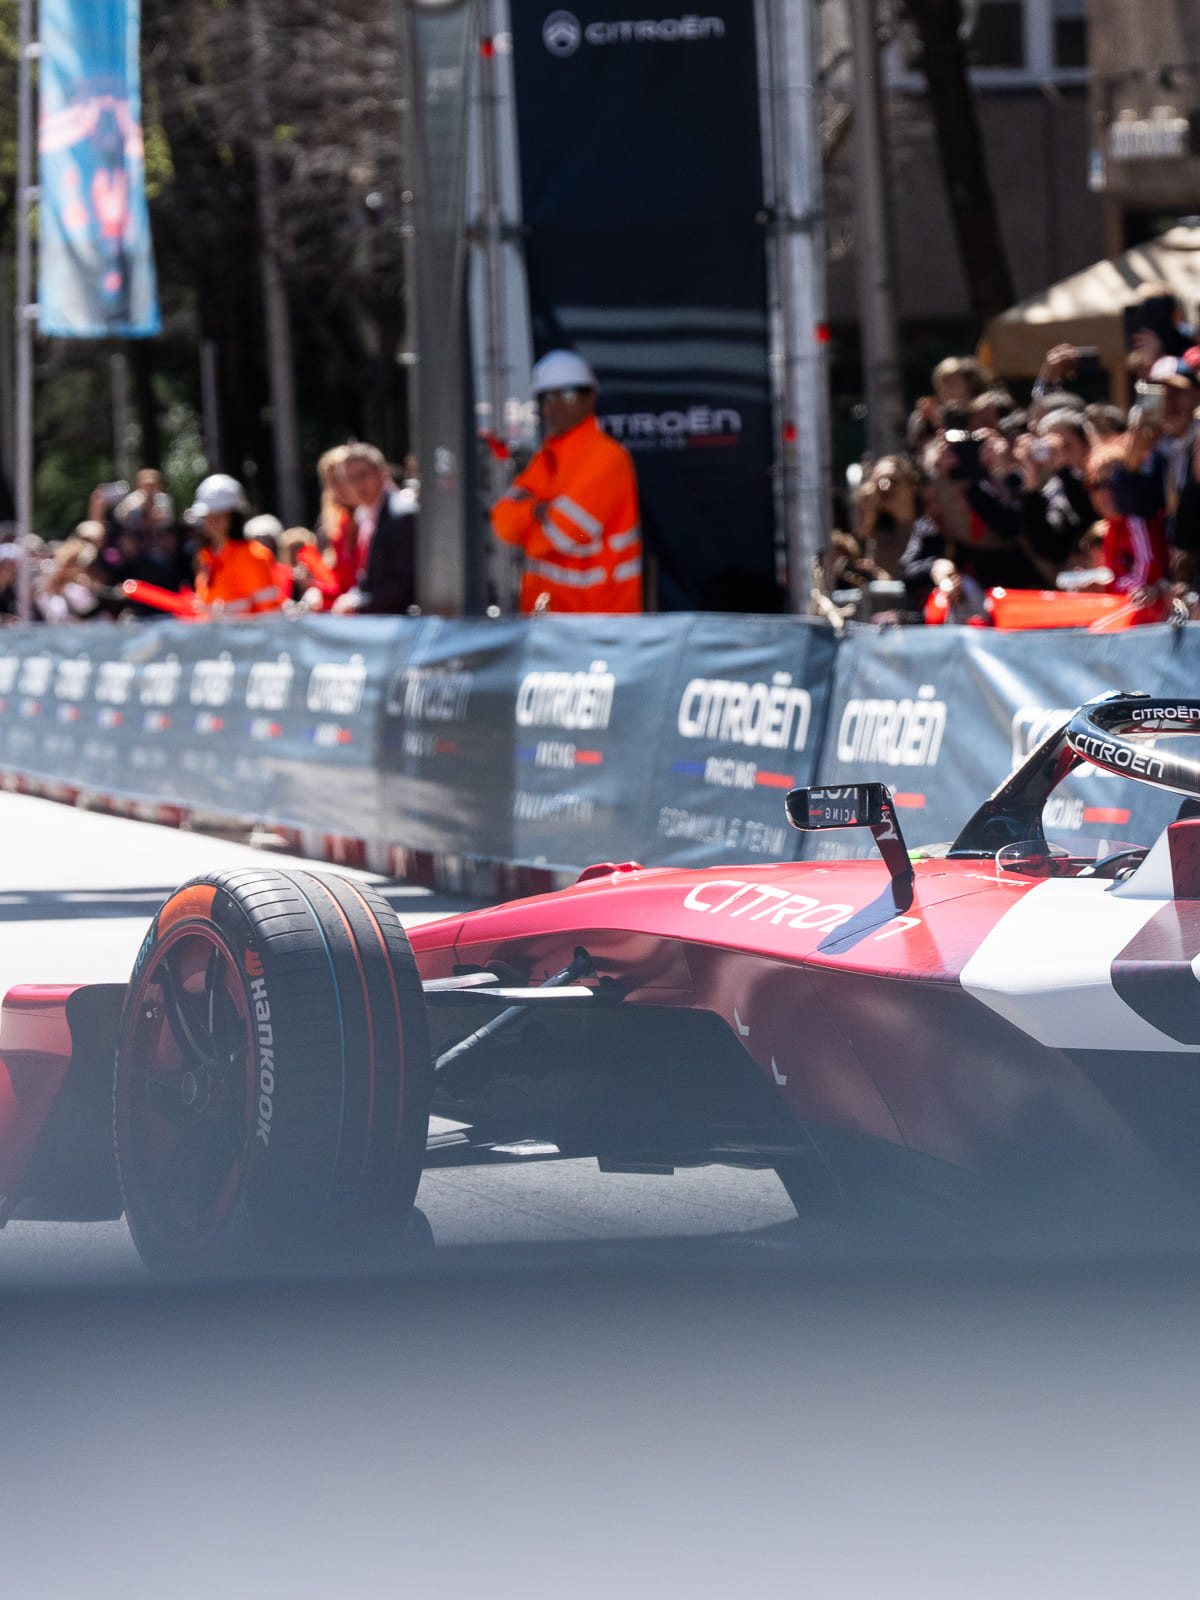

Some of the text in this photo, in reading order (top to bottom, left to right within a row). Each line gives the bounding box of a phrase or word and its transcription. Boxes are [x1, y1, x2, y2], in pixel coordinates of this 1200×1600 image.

[584, 15, 725, 45] CITROËN
[677, 671, 812, 752] CITROËN
[837, 685, 948, 767] CITROËN
[683, 879, 921, 941] CITRON
